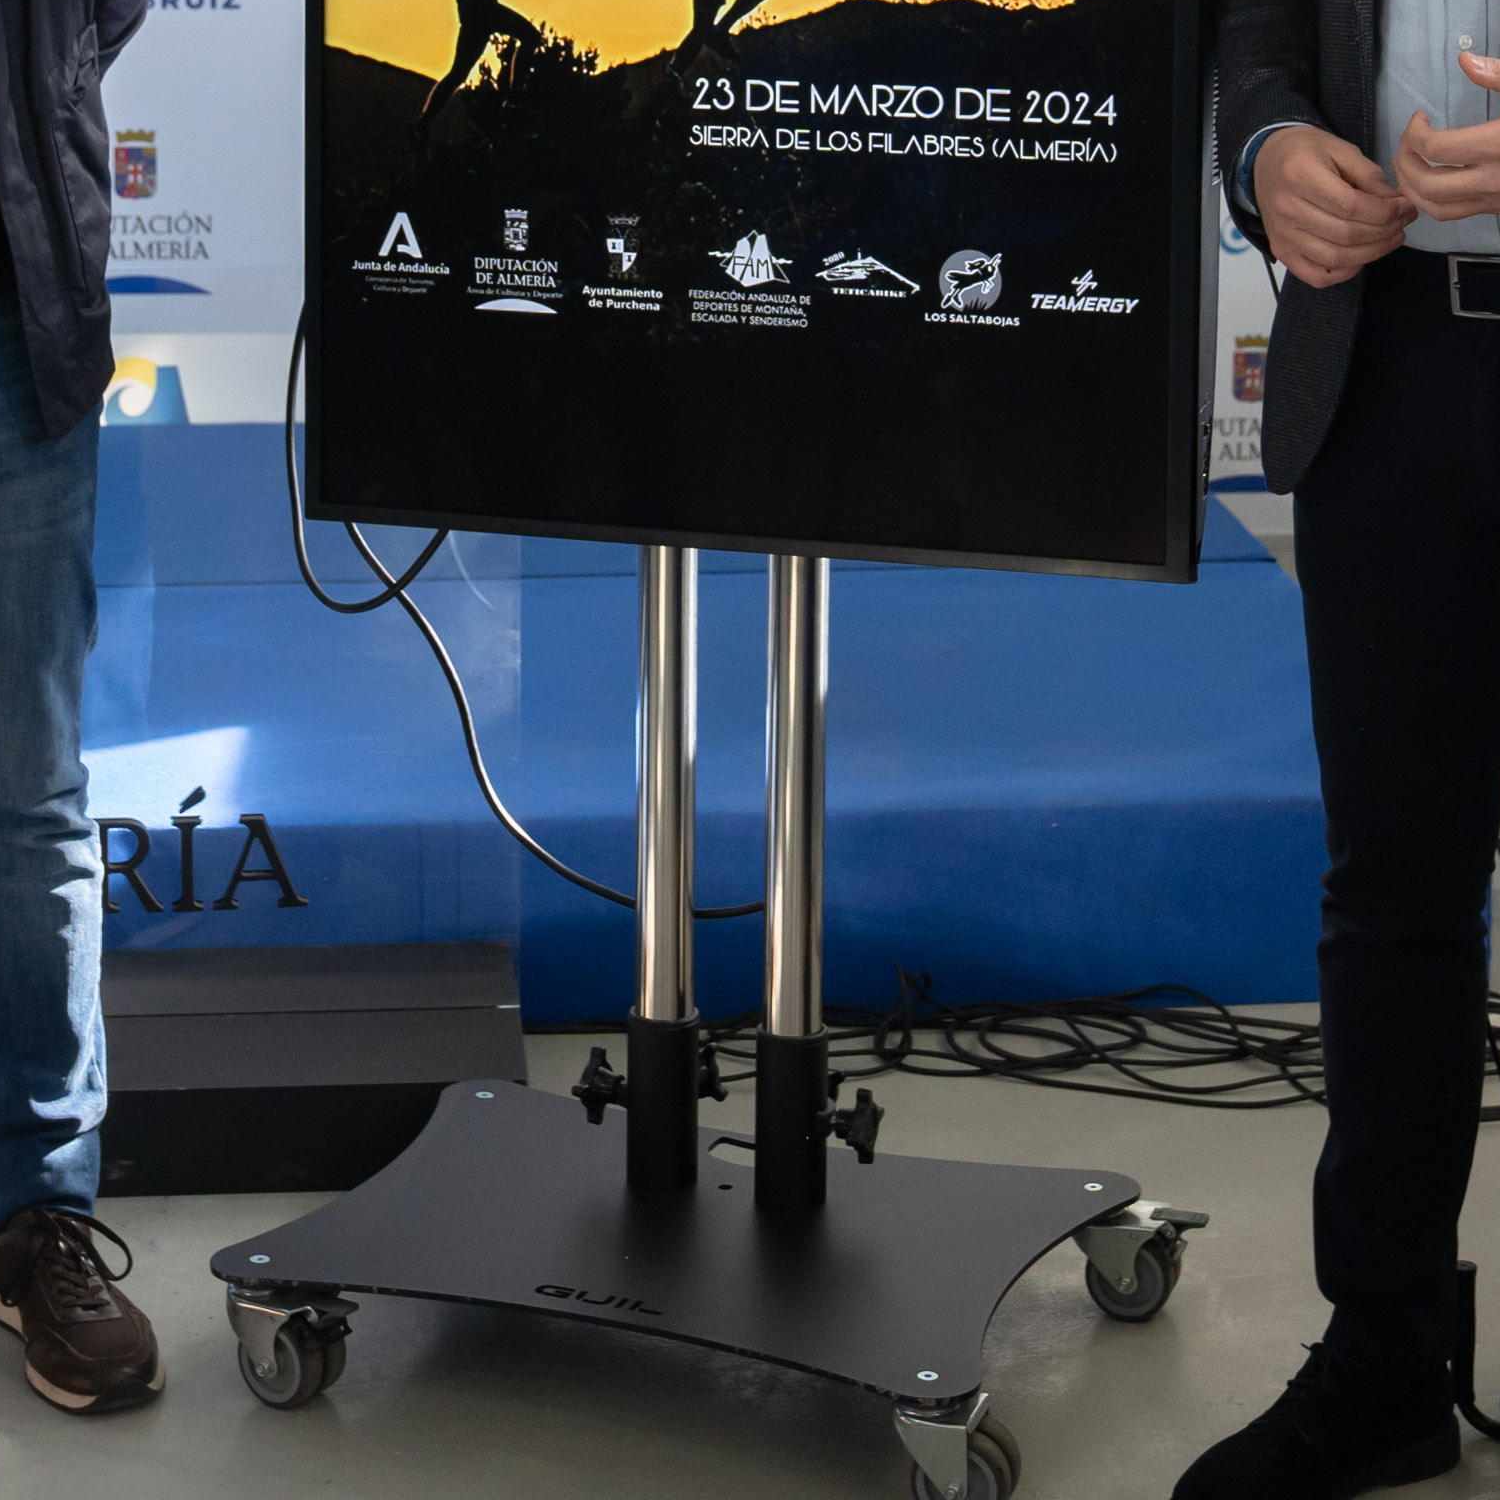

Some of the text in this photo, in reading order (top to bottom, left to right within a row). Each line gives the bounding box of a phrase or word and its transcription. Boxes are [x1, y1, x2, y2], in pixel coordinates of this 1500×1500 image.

[692, 77, 1117, 126] 23 DE MARZO DE 2024
[689, 124, 1118, 164] SIERRA DE LOS FILABRES (ALMERÍA)
[111, 211, 213, 236] TACIÓN
[352, 260, 450, 275] Junta de Andalucía
[474, 257, 558, 273] DIPUTACIÓN
[476, 272, 557, 288] DE ALMERÍA
[582, 285, 663, 299] Ayuntamiento
[688, 289, 811, 305] FEDERACIÓN ANDALUZA DE
[588, 298, 660, 311] de Purchena
[693, 301, 807, 317] DEPORTES DE MONTAÑA,
[1031, 293, 1139, 314] TEAMERGY
[691, 312, 808, 328] ESCALADA Y SENDERISMO
[924, 312, 1020, 327] LOS SALTABOJAS
[534, 1284, 663, 1316] GUIL
